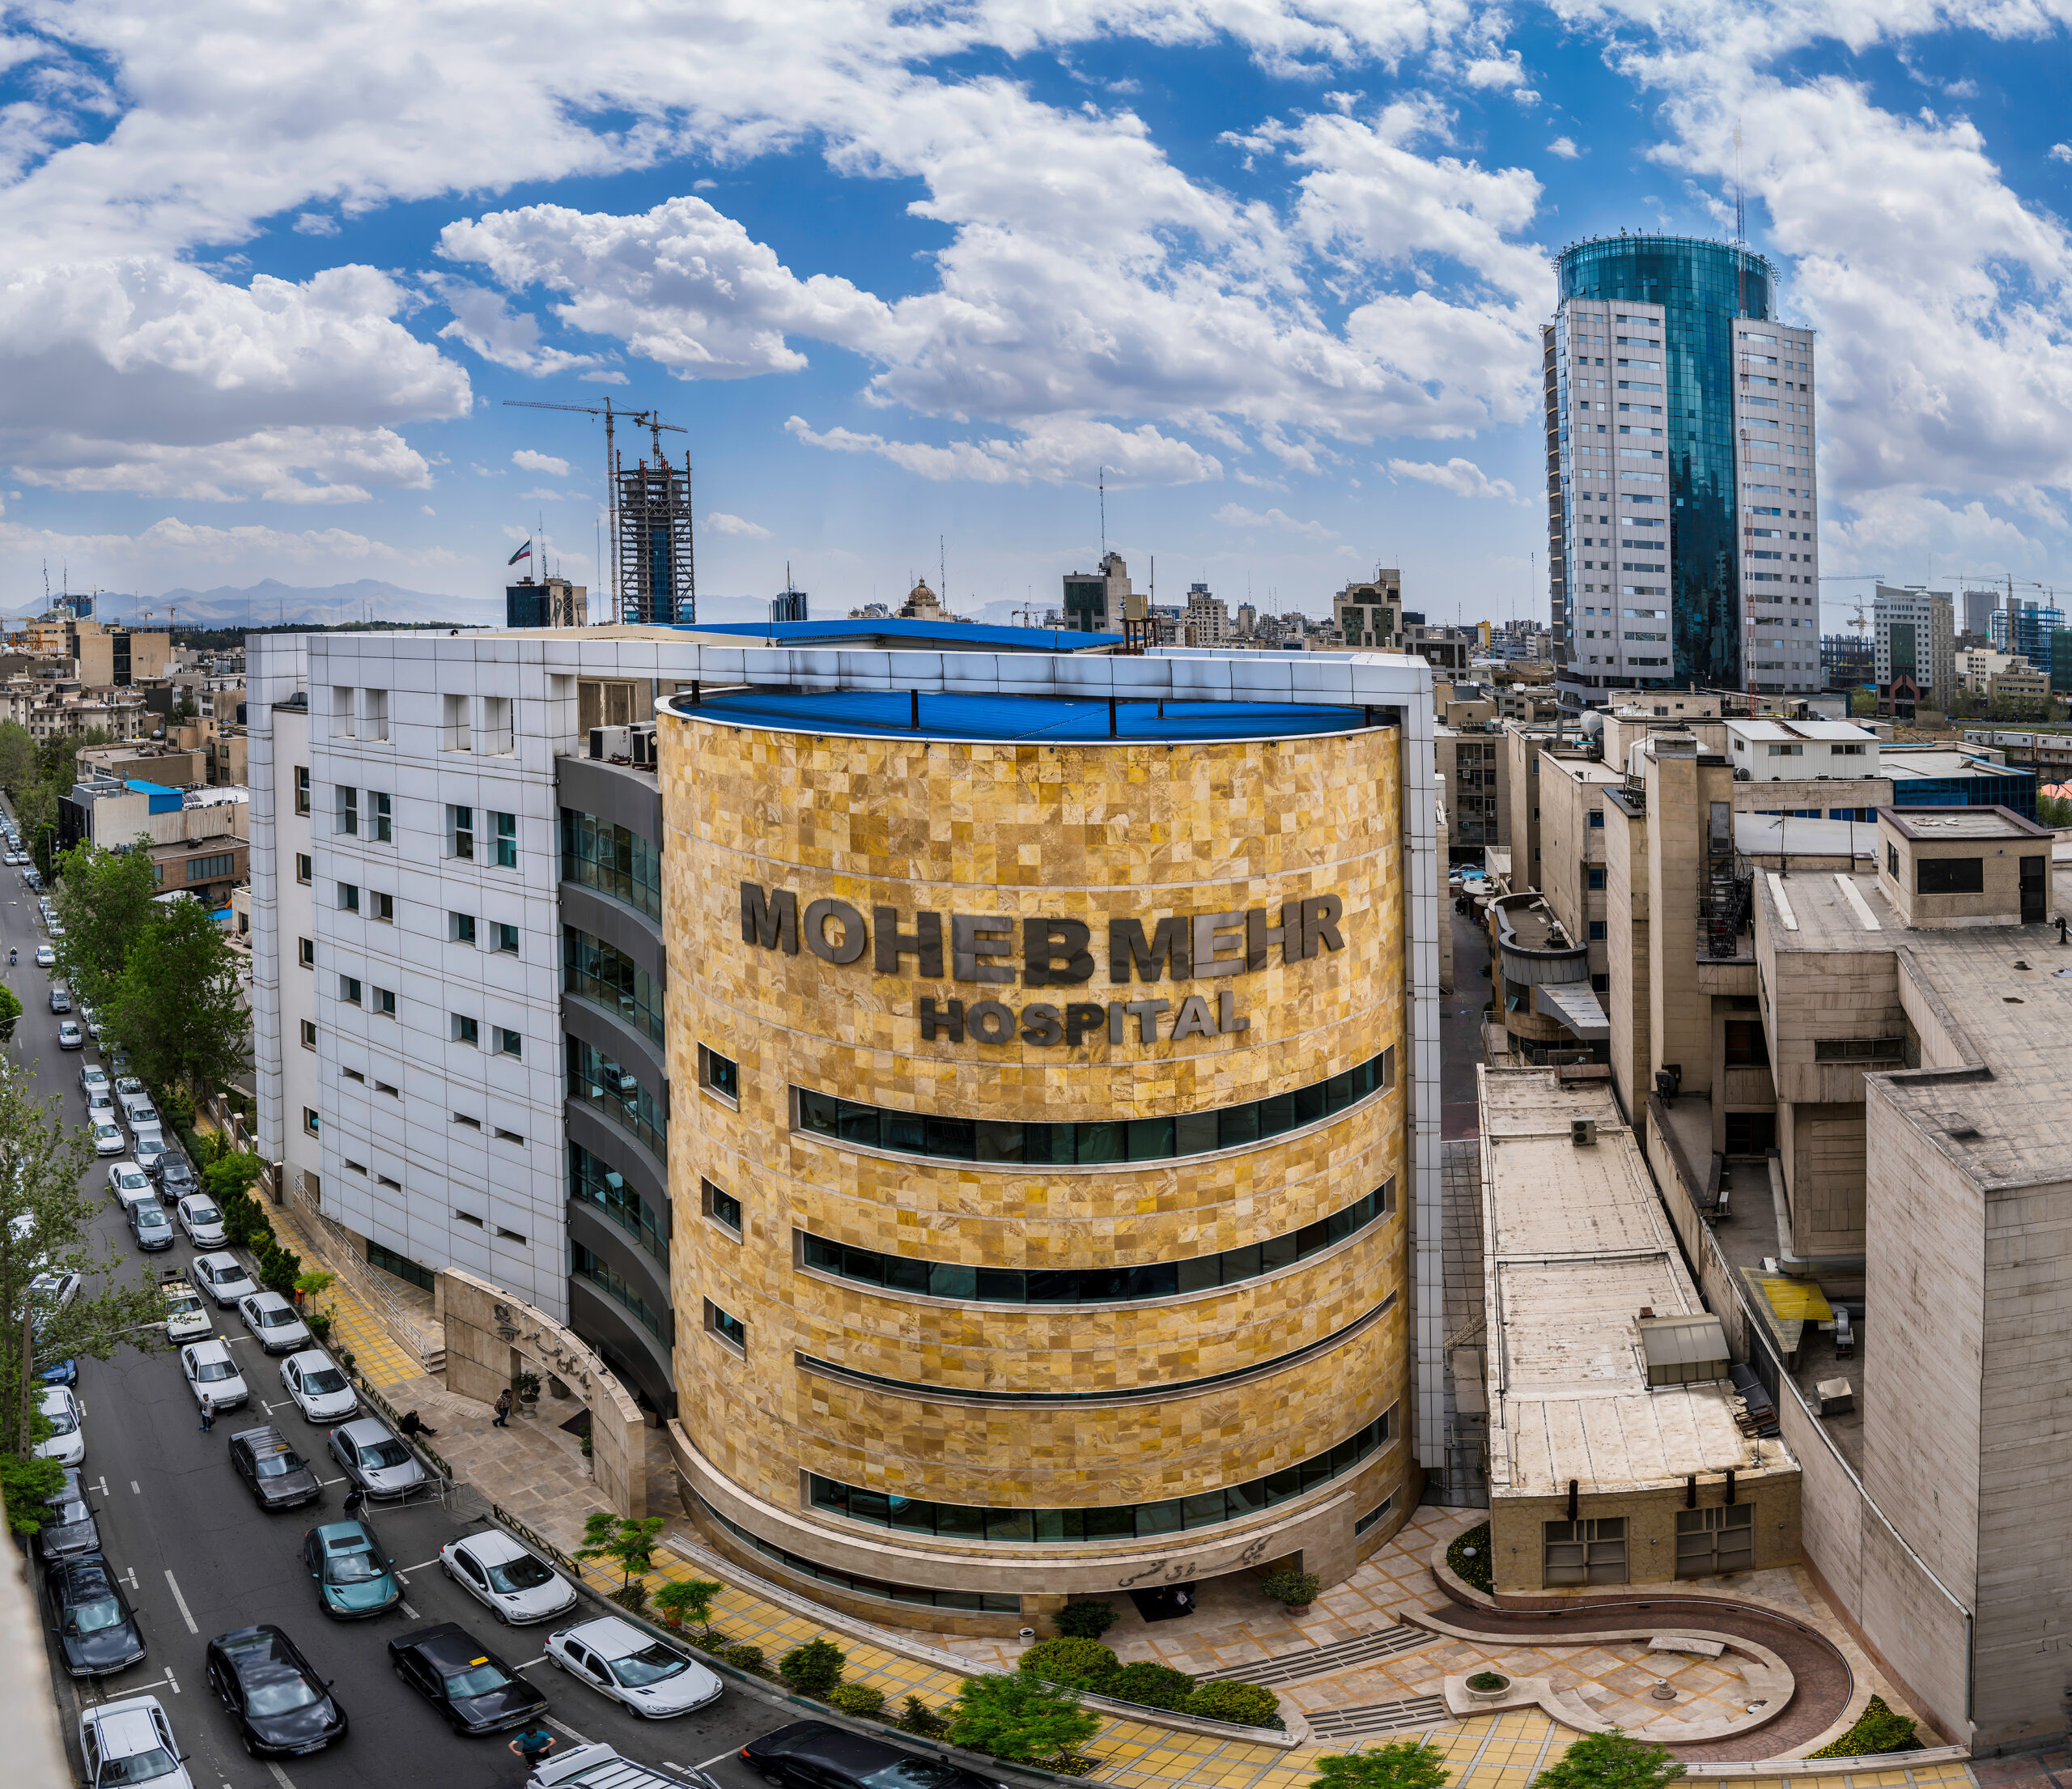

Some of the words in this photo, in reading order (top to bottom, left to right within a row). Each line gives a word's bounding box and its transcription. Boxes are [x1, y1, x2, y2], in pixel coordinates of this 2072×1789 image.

[740, 880, 1094, 985] MOHEB
[1109, 894, 1346, 984] MEHR
[920, 992, 1251, 1047] HOSPITAL
